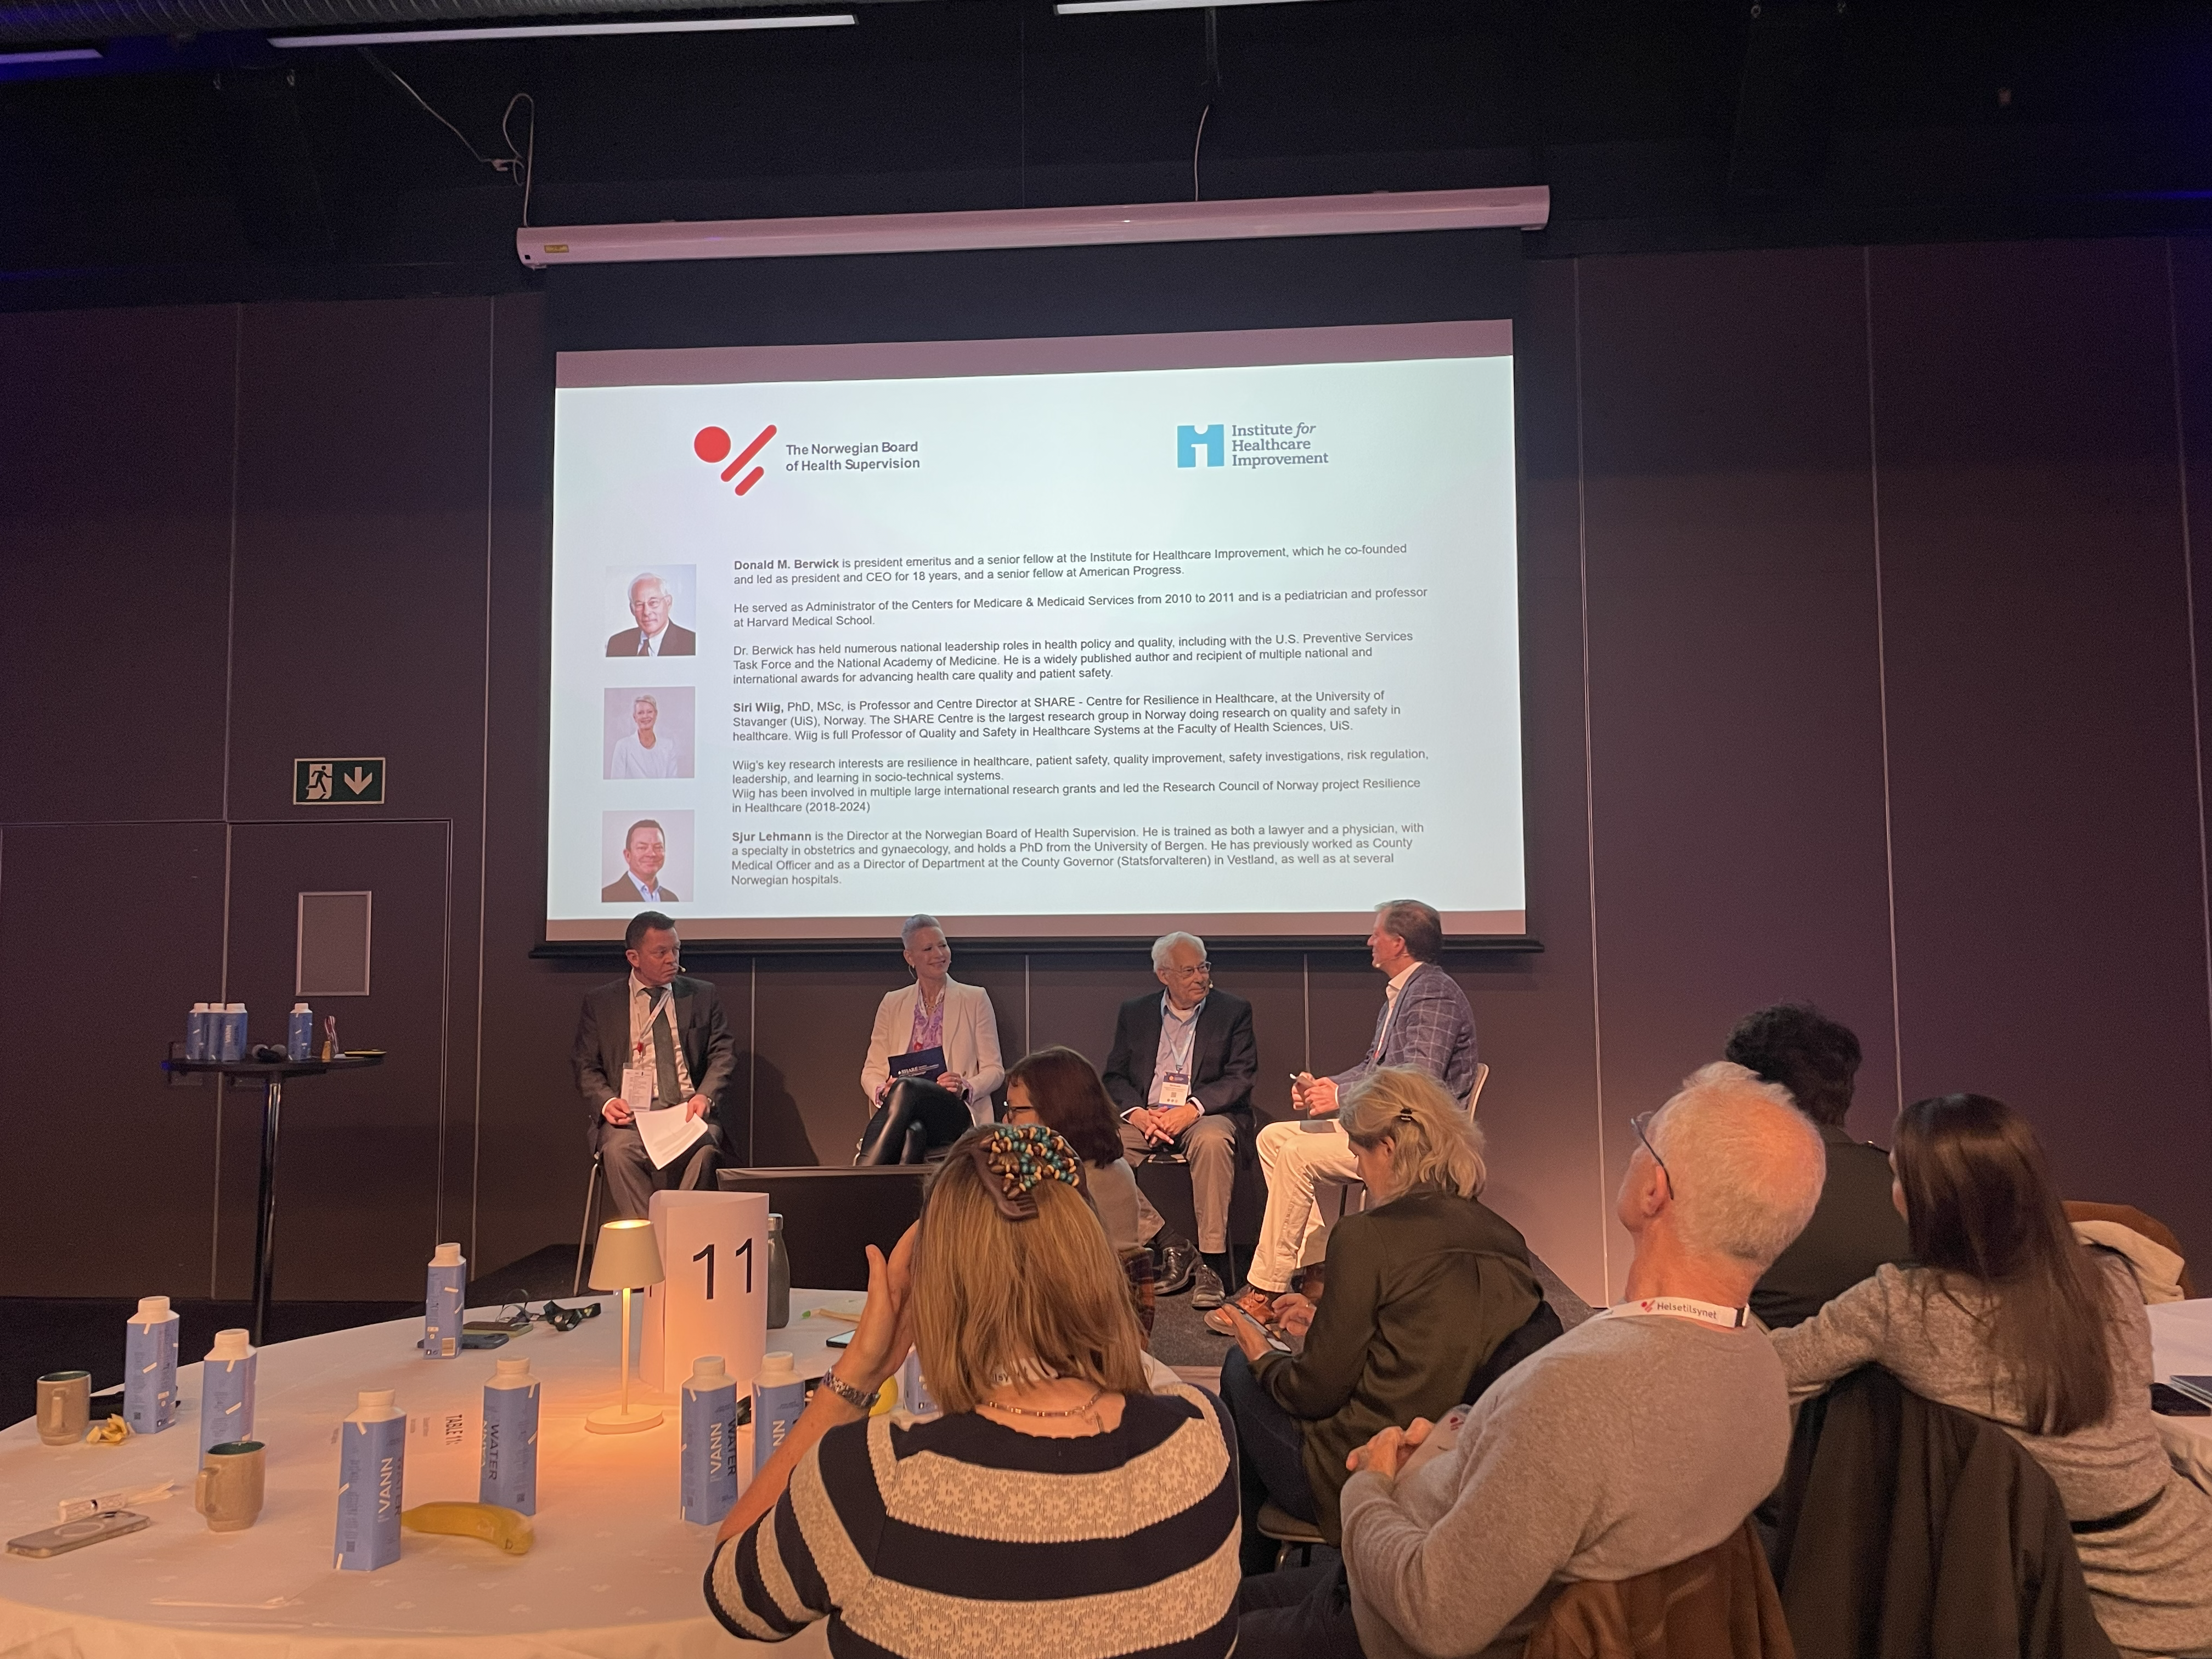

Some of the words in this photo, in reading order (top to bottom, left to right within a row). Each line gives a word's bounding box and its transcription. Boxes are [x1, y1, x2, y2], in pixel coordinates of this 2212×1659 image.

[1232, 424, 1293, 437] Institute
[1293, 422, 1317, 438] for
[786, 444, 809, 455] The
[811, 442, 879, 456] Norwegian
[882, 441, 918, 452] Board
[1232, 438, 1311, 452] Healthcare
[786, 460, 799, 471] of
[802, 459, 842, 471] Health
[845, 458, 920, 472] Supervision
[1232, 453, 1329, 469] Improvement
[734, 560, 774, 570] Donald
[777, 560, 791, 569] M.
[794, 558, 839, 568] Berwick
[842, 558, 851, 567] is
[854, 558, 904, 570] president
[906, 557, 952, 567] emeritus
[954, 556, 974, 565] and
[987, 555, 1020, 565] senior
[1023, 554, 1054, 564] fellow
[1056, 554, 1068, 562] at
[1070, 554, 1087, 562] the
[1090, 552, 1132, 562] Institute
[1135, 551, 1150, 561] for
[1153, 549, 1211, 560] Healthcare
[1215, 548, 1289, 561] Improvement,
[1292, 546, 1324, 556] which
[1327, 546, 1341, 555] he
[1344, 544, 1407, 555] co-founded
[733, 575, 754, 584] and
[757, 574, 772, 583] led
[791, 573, 840, 585] president
[843, 573, 863, 582] and
[866, 572, 892, 582] CEO
[894, 572, 910, 581] for
[912, 571, 926, 581] 18
[928, 573, 961, 583] years,
[964, 570, 984, 579] and
[997, 569, 1030, 578] senior
[1032, 568, 1064, 578] fellow
[1066, 568, 1077, 577] at
[1079, 566, 1130, 577] American
[1133, 565, 1184, 577] Progress.
[733, 618, 744, 627] at
[747, 617, 789, 627] Harvard
[792, 617, 833, 626] Medical
[835, 616, 875, 625] School.
[733, 646, 749, 655] Dr.
[752, 645, 794, 655] Berwick
[796, 645, 816, 654] has
[819, 644, 842, 653] held
[900, 642, 942, 652] national
[945, 641, 1000, 654] leadership
[1003, 640, 1029, 650] roles
[1031, 640, 1042, 649] in
[1045, 640, 1077, 649] health
[1080, 639, 1111, 651] policy
[1114, 639, 1135, 647] and
[1137, 637, 1175, 650] quality,
[1178, 636, 1227, 649] including
[1229, 635, 1252, 645] with
[1254, 635, 1273, 645] the
[1276, 634, 1300, 644] U.S.
[1303, 633, 1362, 643] Preventive
[1364, 631, 1413, 642] Services
[732, 731, 792, 741] healthcare.
[793, 730, 818, 742] Wiig
[821, 730, 830, 740] is
[832, 730, 848, 740] full
[851, 729, 903, 739] Professor
[905, 729, 917, 738] of
[918, 729, 957, 740] Quality
[958, 728, 979, 737] and
[982, 727, 1017, 739] Safety
[1019, 727, 1029, 736] in
[1032, 726, 1091, 736] Healthcare
[1093, 725, 1141, 737] Systems
[1143, 725, 1154, 733] at
[1156, 724, 1175, 733] the
[1177, 724, 1218, 736] Faculty
[1219, 723, 1232, 732] of
[1234, 723, 1269, 732] Health
[1272, 721, 1327, 732] Sciences,
[1329, 720, 1353, 730] UiS.
[732, 760, 765, 772] Wiig's
[767, 760, 787, 772] key
[789, 759, 836, 769] research
[838, 759, 884, 769] interests
[907, 758, 958, 767] resilience
[961, 757, 970, 766] in
[973, 757, 1032, 767] healthcare,
[1036, 755, 1073, 767] patient
[1075, 755, 1110, 766] safety,
[1113, 754, 1149, 766] quality
[1152, 753, 1226, 765] improvement,
[1228, 752, 1263, 764] safety
[1265, 750, 1344, 764] investigations,
[1347, 750, 1367, 759] risk
[1370, 749, 1429, 761] regulation,
[732, 774, 791, 786] leadership,
[793, 774, 814, 783] and
[816, 772, 859, 785] learning
[861, 772, 872, 782] in
[874, 771, 953, 781] socio-technical
[956, 771, 1005, 783] systems.
[732, 804, 742, 812] in
[744, 803, 803, 812] Healthcare
[805, 802, 871, 814] (2018-2024)
[732, 832, 756, 844] Sjur
[759, 832, 812, 842] Lehmann
[815, 831, 824, 840] is
[827, 831, 844, 840] the
[847, 831, 890, 840] Director
[891, 831, 902, 840] at
[905, 831, 922, 839] the
[925, 830, 983, 842] Norwegian
[985, 829, 1018, 839] Board
[1020, 829, 1032, 838] of
[1034, 828, 1070, 838] Health
[1072, 827, 1139, 840] Supervision.
[1142, 827, 1159, 836] He
[1161, 827, 1171, 836] is
[1173, 826, 1211, 836] trained
[1231, 826, 1256, 835] both
[1268, 825, 1305, 837] lawyer
[1307, 825, 1329, 834] and
[1342, 823, 1398, 837] physician,
[1401, 823, 1424, 832] with
[731, 875, 788, 888] Norwegian
[792, 874, 842, 887] hospitals.
[901, 1066, 919, 1075] SHARE
[692, 1238, 753, 1300] 11
[1657, 1302, 1718, 1319] Helsetilsynet
[445, 1414, 463, 1436] TABLE
[488, 1424, 500, 1481] WATER
[710, 1422, 722, 1475] VANN
[378, 1457, 393, 1514] VANN
